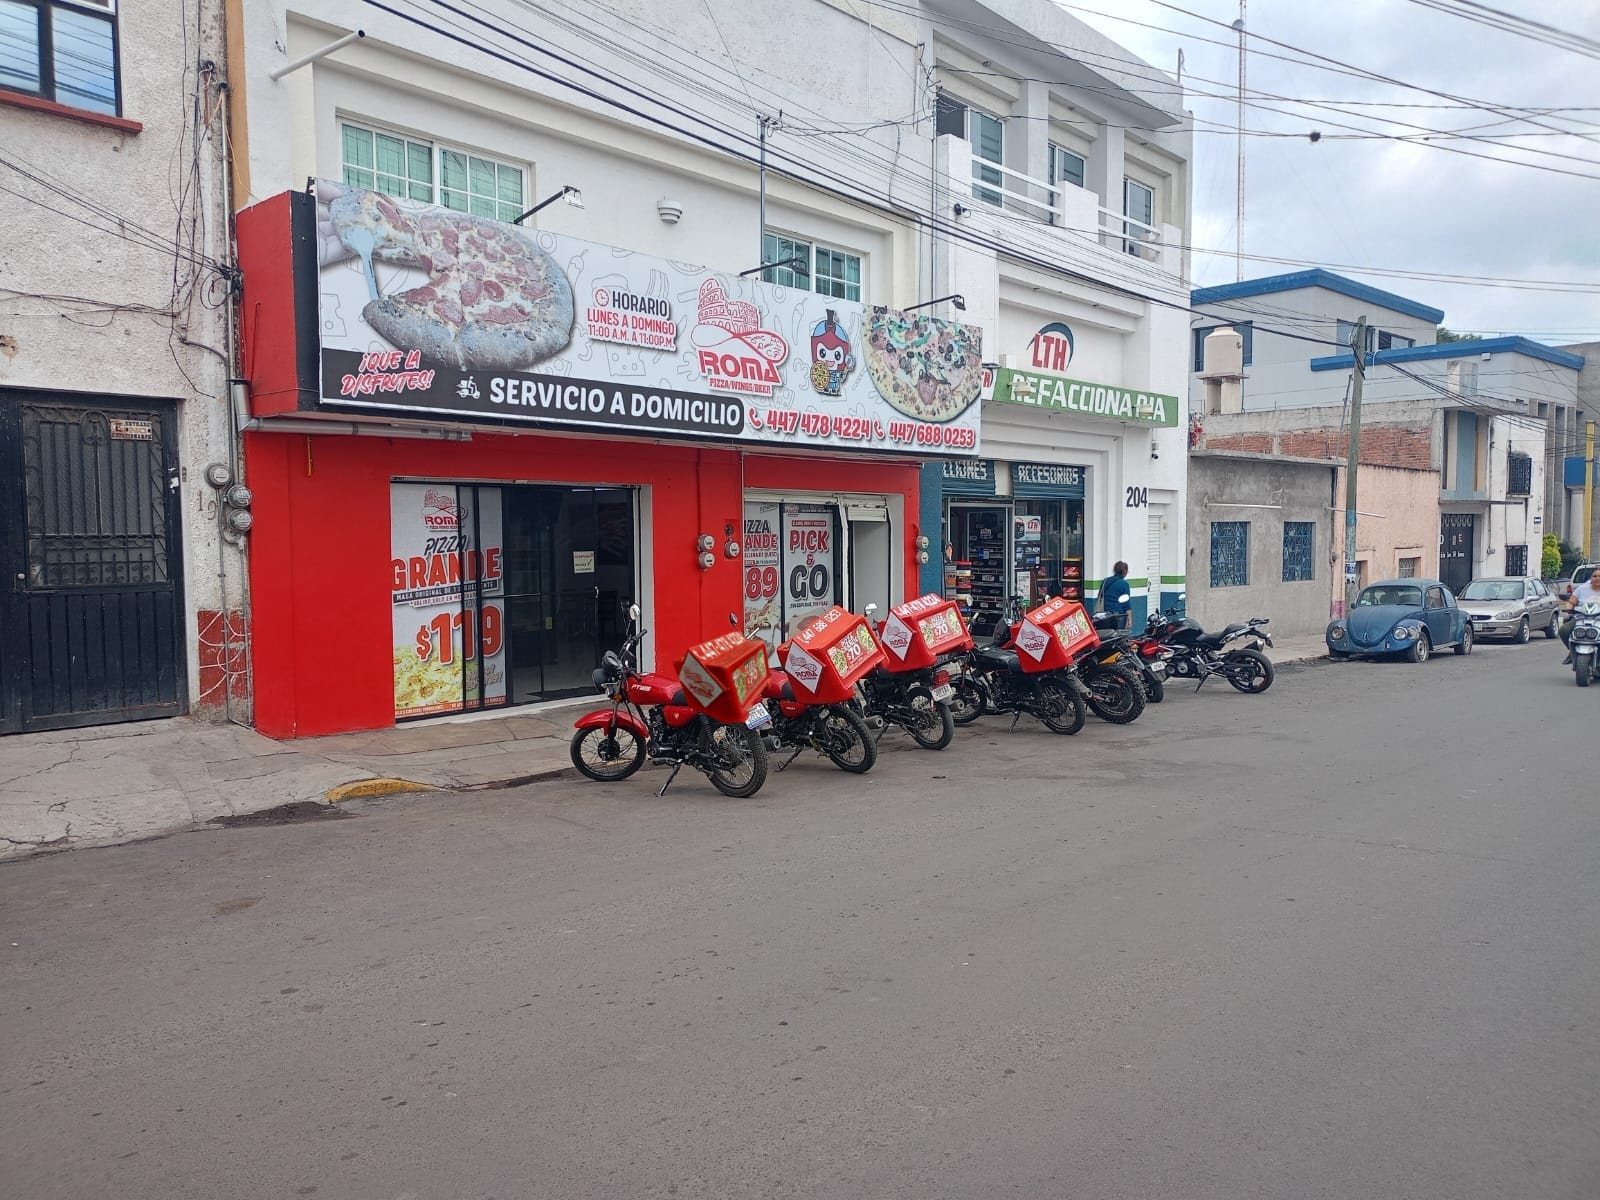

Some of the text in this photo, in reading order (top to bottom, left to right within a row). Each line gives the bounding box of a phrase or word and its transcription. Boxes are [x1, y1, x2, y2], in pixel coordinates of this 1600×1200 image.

[612, 290, 668, 317] HORARIO
[587, 308, 675, 336] LUNES A DOMINGO
[588, 324, 610, 338] 11:00
[612, 328, 630, 341] A.M.
[631, 331, 638, 343] A
[358, 349, 421, 373] ¡QUE LA
[1032, 333, 1068, 371] LTH
[698, 350, 781, 383] ROMA
[341, 369, 435, 398] DISFRUTES!
[489, 377, 741, 426] SERVICIO A DOMICILIO
[766, 409, 871, 439] 447 478 4224
[889, 421, 975, 447] 447 688 0253
[1018, 465, 1080, 485] ACCESORIOS
[1126, 486, 1148, 508] 204
[744, 520, 770, 534] IZZA
[424, 534, 469, 556] PIZZA
[745, 534, 777, 549] ANDE
[789, 530, 828, 551] PICK
[391, 547, 501, 590] GRANDE
[806, 554, 814, 567] &
[790, 564, 828, 599] GO
[416, 605, 503, 664] $119
[847, 643, 861, 661] $70
